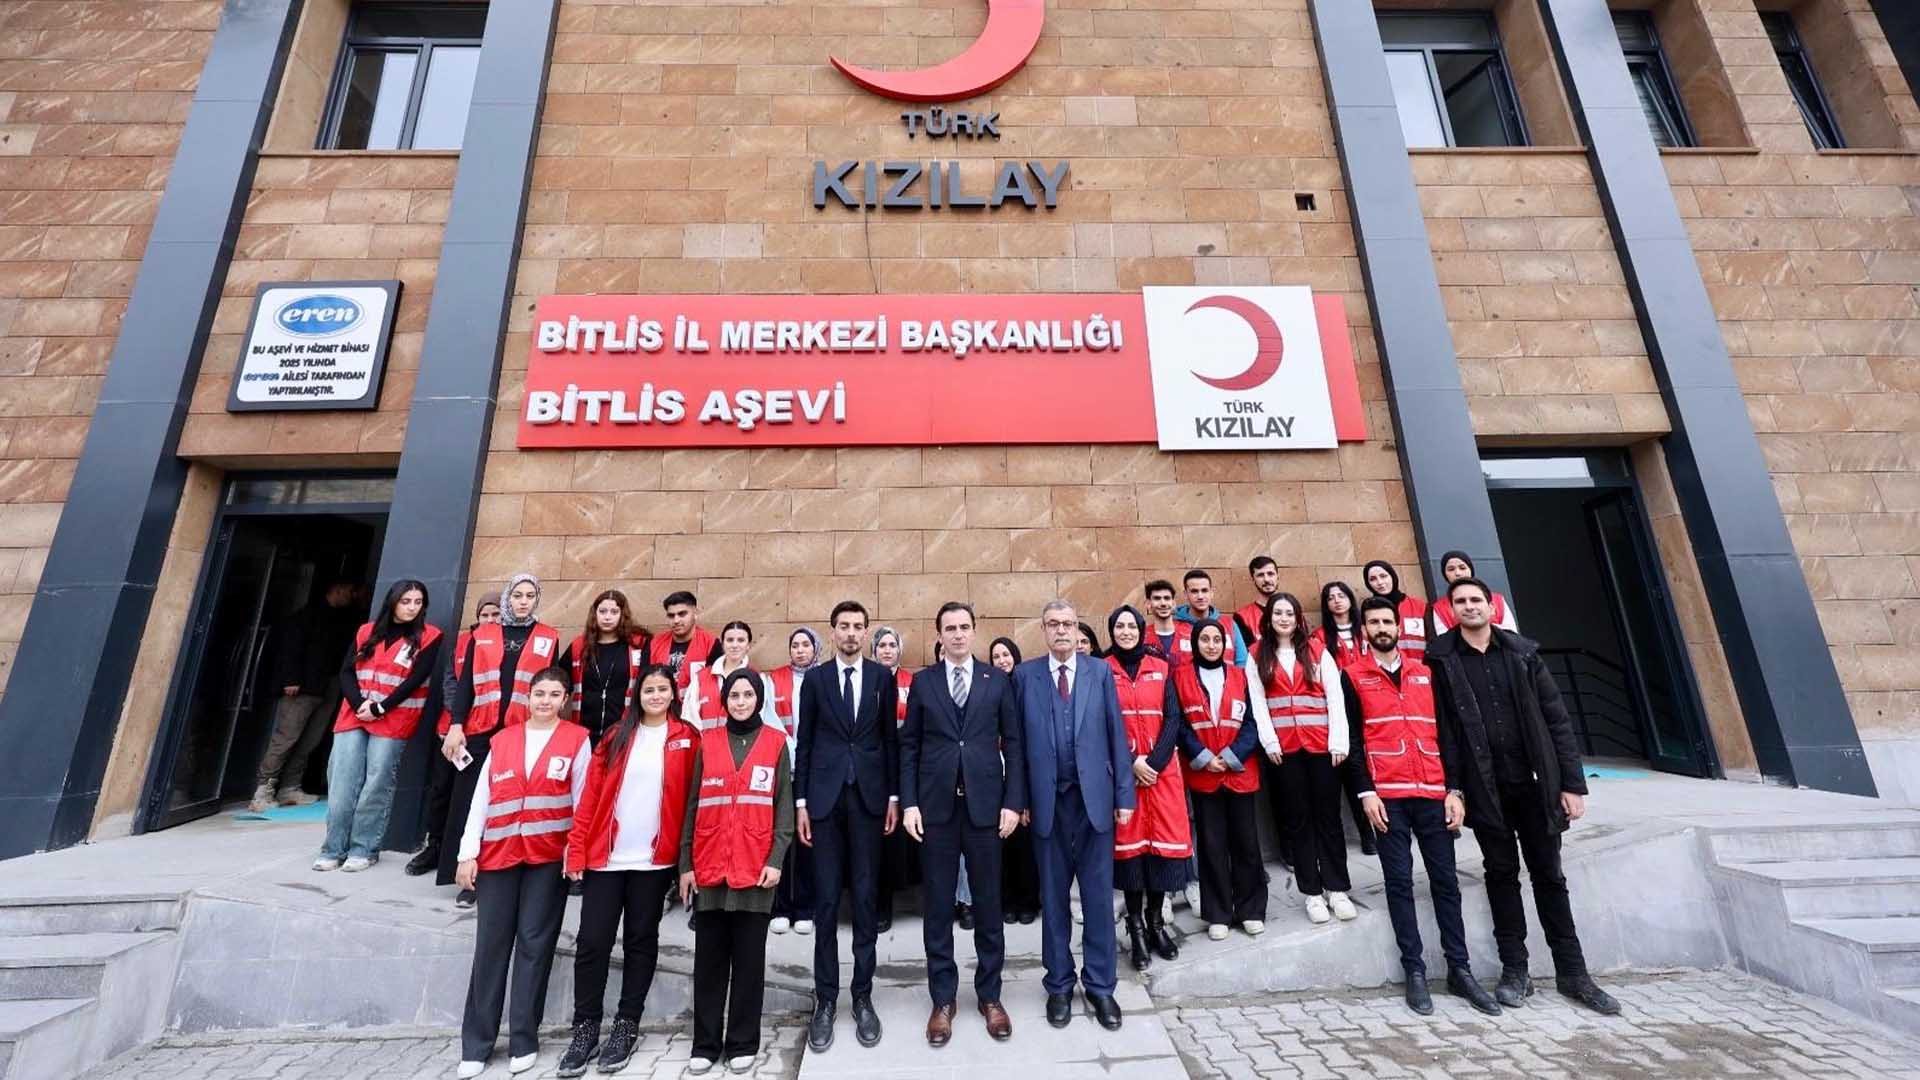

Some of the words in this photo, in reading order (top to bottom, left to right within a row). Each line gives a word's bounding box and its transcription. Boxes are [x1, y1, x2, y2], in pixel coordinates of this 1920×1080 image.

[901, 106, 1000, 139] TÜRK
[814, 160, 1070, 209] KIZILAY
[282, 307, 355, 323] eren
[537, 315, 664, 352] BİTLİS
[673, 315, 710, 352] İL
[719, 315, 888, 352] MERKEZİ
[900, 314, 1124, 359] BAŞKANLIĞI
[252, 345, 266, 355] BU
[267, 342, 293, 356] AŞEVİ
[294, 344, 305, 354] VE
[306, 342, 339, 354] HİZMET
[340, 341, 370, 353] BİNASI
[279, 358, 300, 368] 2025
[303, 358, 336, 367] YILINDA
[281, 369, 310, 381] AİLESİ
[311, 371, 366, 381] TARAFINDAN
[526, 383, 686, 424] BİTLİS
[698, 381, 847, 430] AŞEVİ
[1223, 399, 1265, 414] TÜRK
[1195, 416, 1295, 438] KIZILAY
